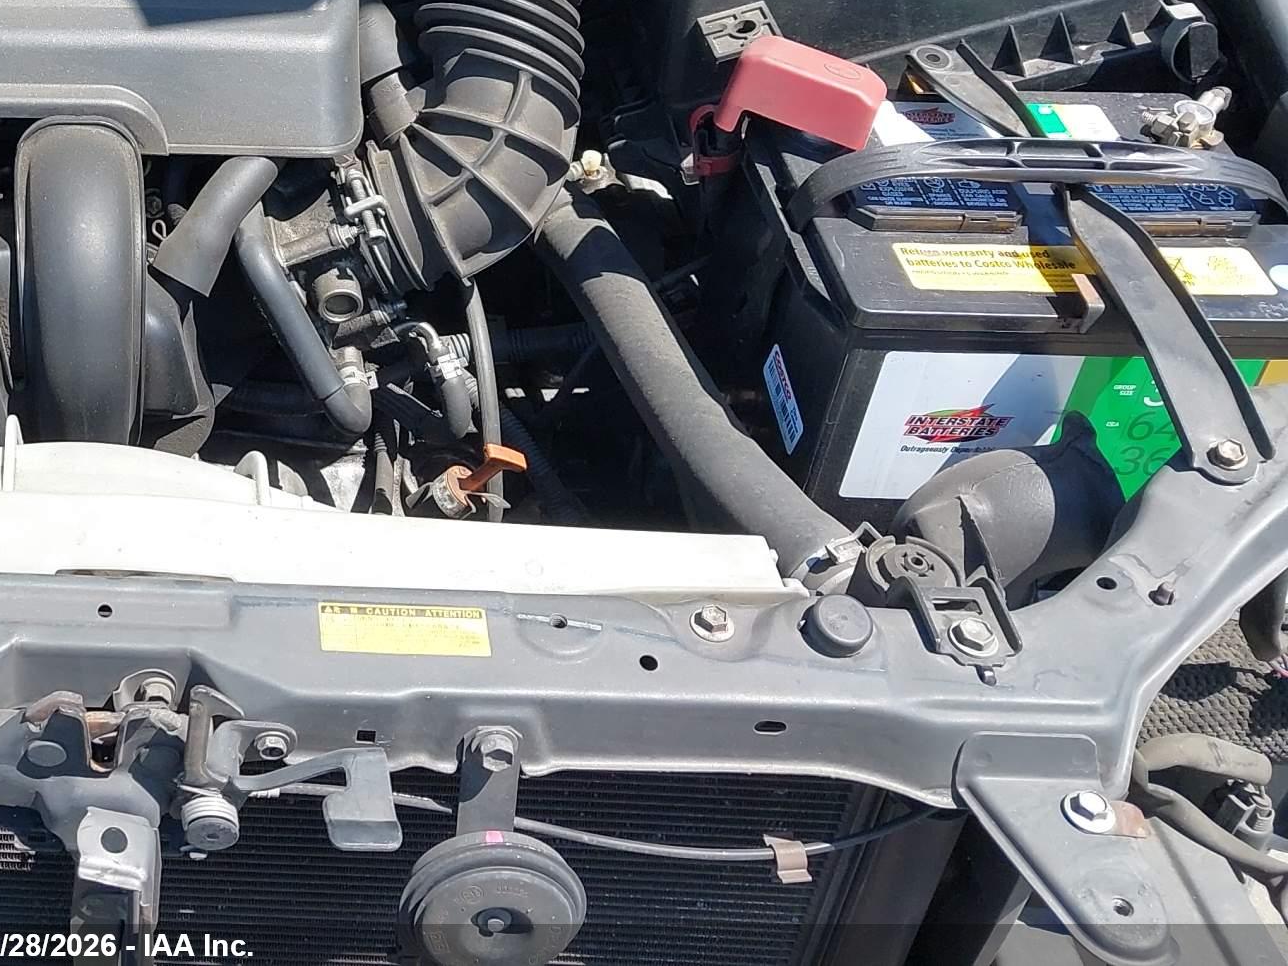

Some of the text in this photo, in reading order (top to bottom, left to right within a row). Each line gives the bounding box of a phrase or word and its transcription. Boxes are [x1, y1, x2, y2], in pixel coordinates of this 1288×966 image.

[941, 249, 995, 259] warranty
[997, 249, 1019, 258] and
[1022, 249, 1050, 259] used
[905, 258, 1076, 270] batteries to Costco Wholesale
[908, 416, 1007, 427] INTERSTATE
[908, 426, 997, 436] BATTERIES
[899, 444, 950, 454] Outrageously
[365, 606, 416, 617] CAUTION
[424, 609, 481, 619] ATTENTION
